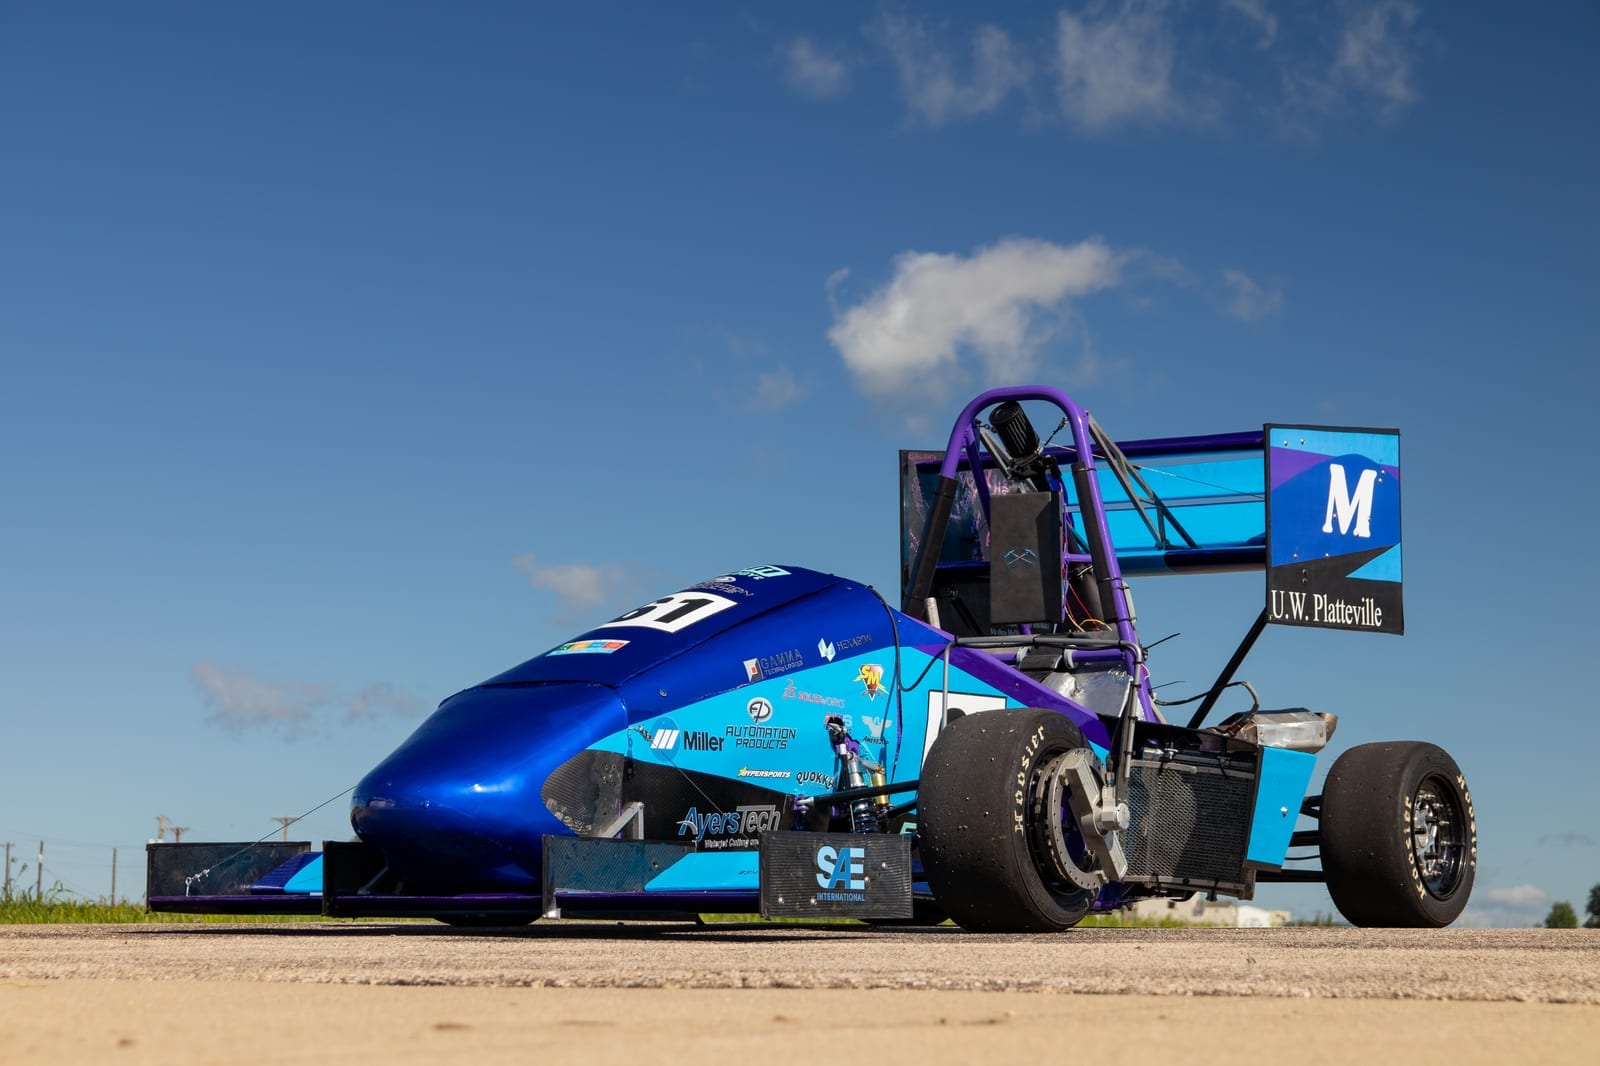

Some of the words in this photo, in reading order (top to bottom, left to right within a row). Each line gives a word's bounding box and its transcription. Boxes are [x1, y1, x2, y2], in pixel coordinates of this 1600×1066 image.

[1322, 463, 1377, 538] M
[1271, 589, 1309, 622] U.W.
[1312, 593, 1383, 627] Platteville
[760, 648, 803, 670] GAMMA
[683, 731, 725, 751] Miller
[726, 725, 797, 739] AUTOMATION
[735, 738, 788, 750] PRODUCTS
[677, 804, 781, 843] AyersTech
[816, 846, 865, 890] SAE
[816, 892, 866, 902] INTERNATIONAL
